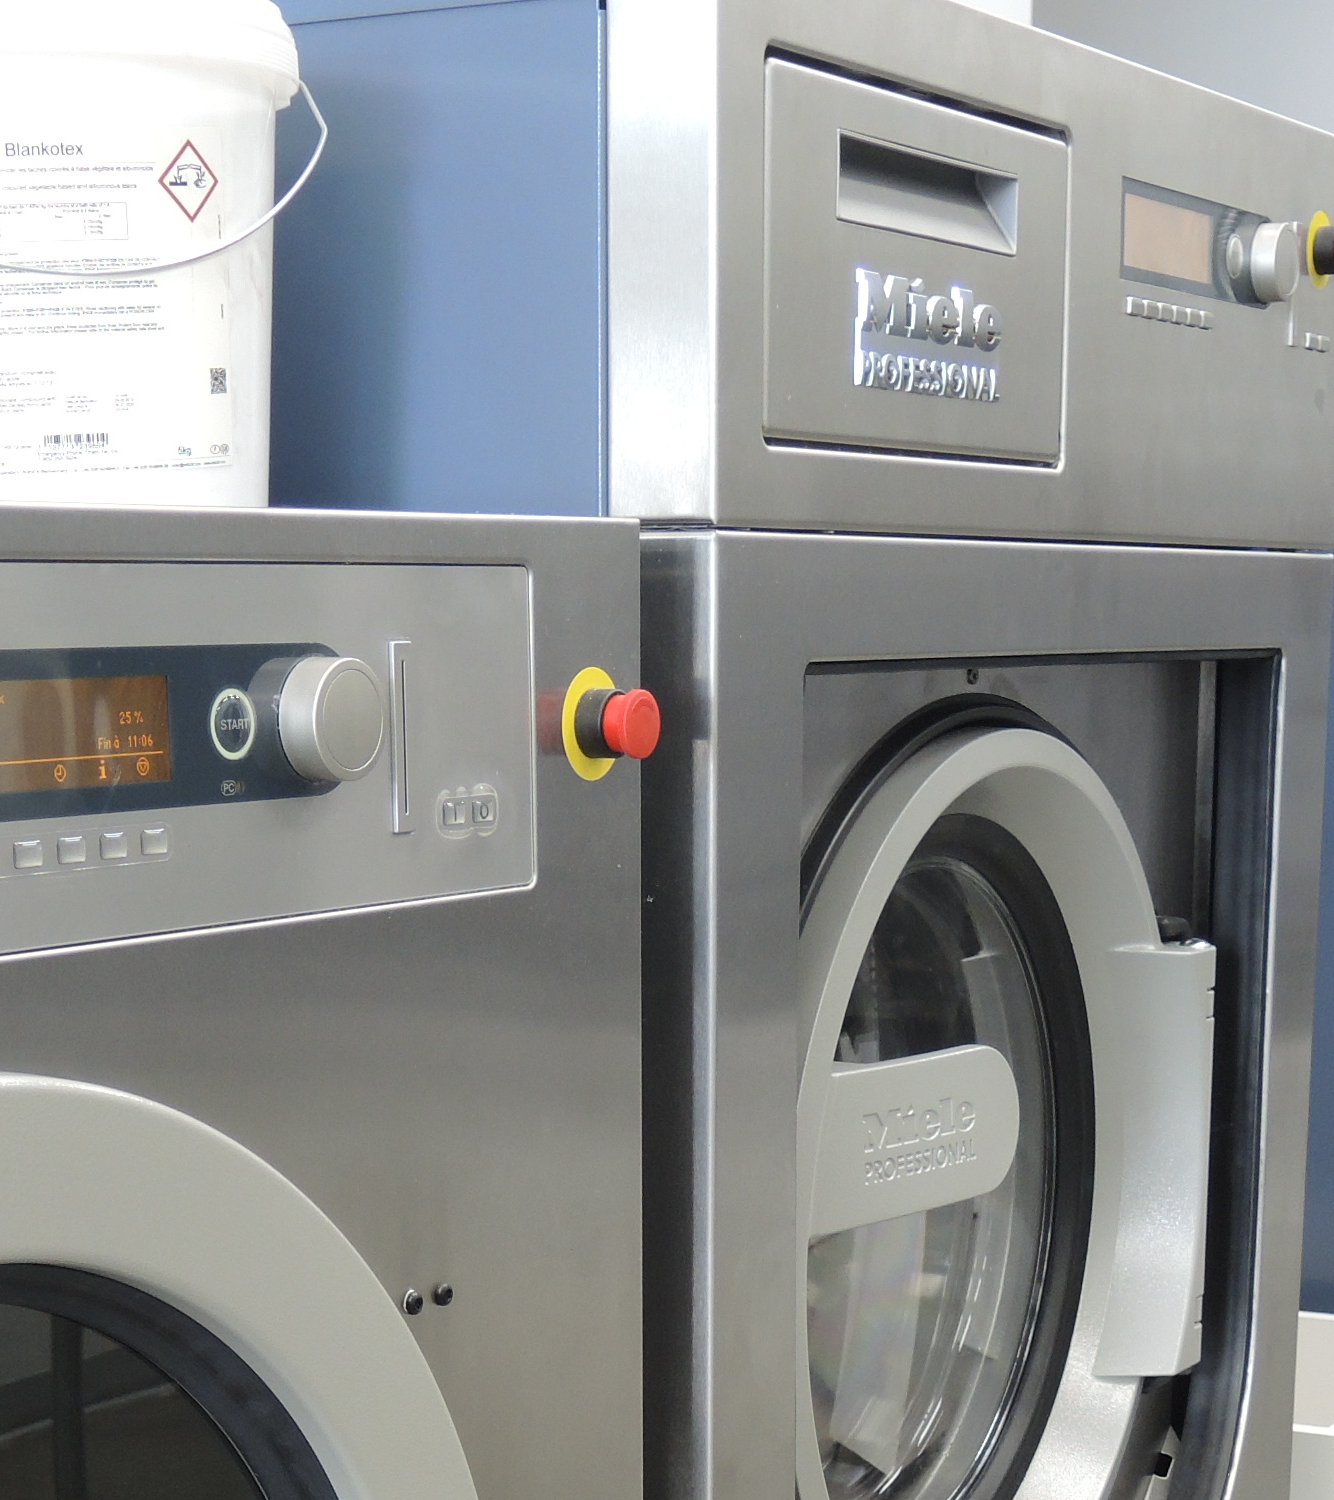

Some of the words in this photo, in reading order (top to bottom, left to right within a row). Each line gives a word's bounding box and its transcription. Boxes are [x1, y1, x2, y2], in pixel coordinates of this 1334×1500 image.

[4, 142, 84, 157] Blankotex
[855, 268, 1002, 352] Miele
[853, 350, 1000, 403] PROFESSIONAL
[119, 711, 132, 725] 25
[220, 718, 249, 731] START
[97, 736, 112, 750] Fin
[127, 734, 154, 748] 11:06
[223, 782, 236, 794] PC
[862, 1097, 976, 1153] Miele
[863, 1138, 977, 1187] PROFESSIONAL
